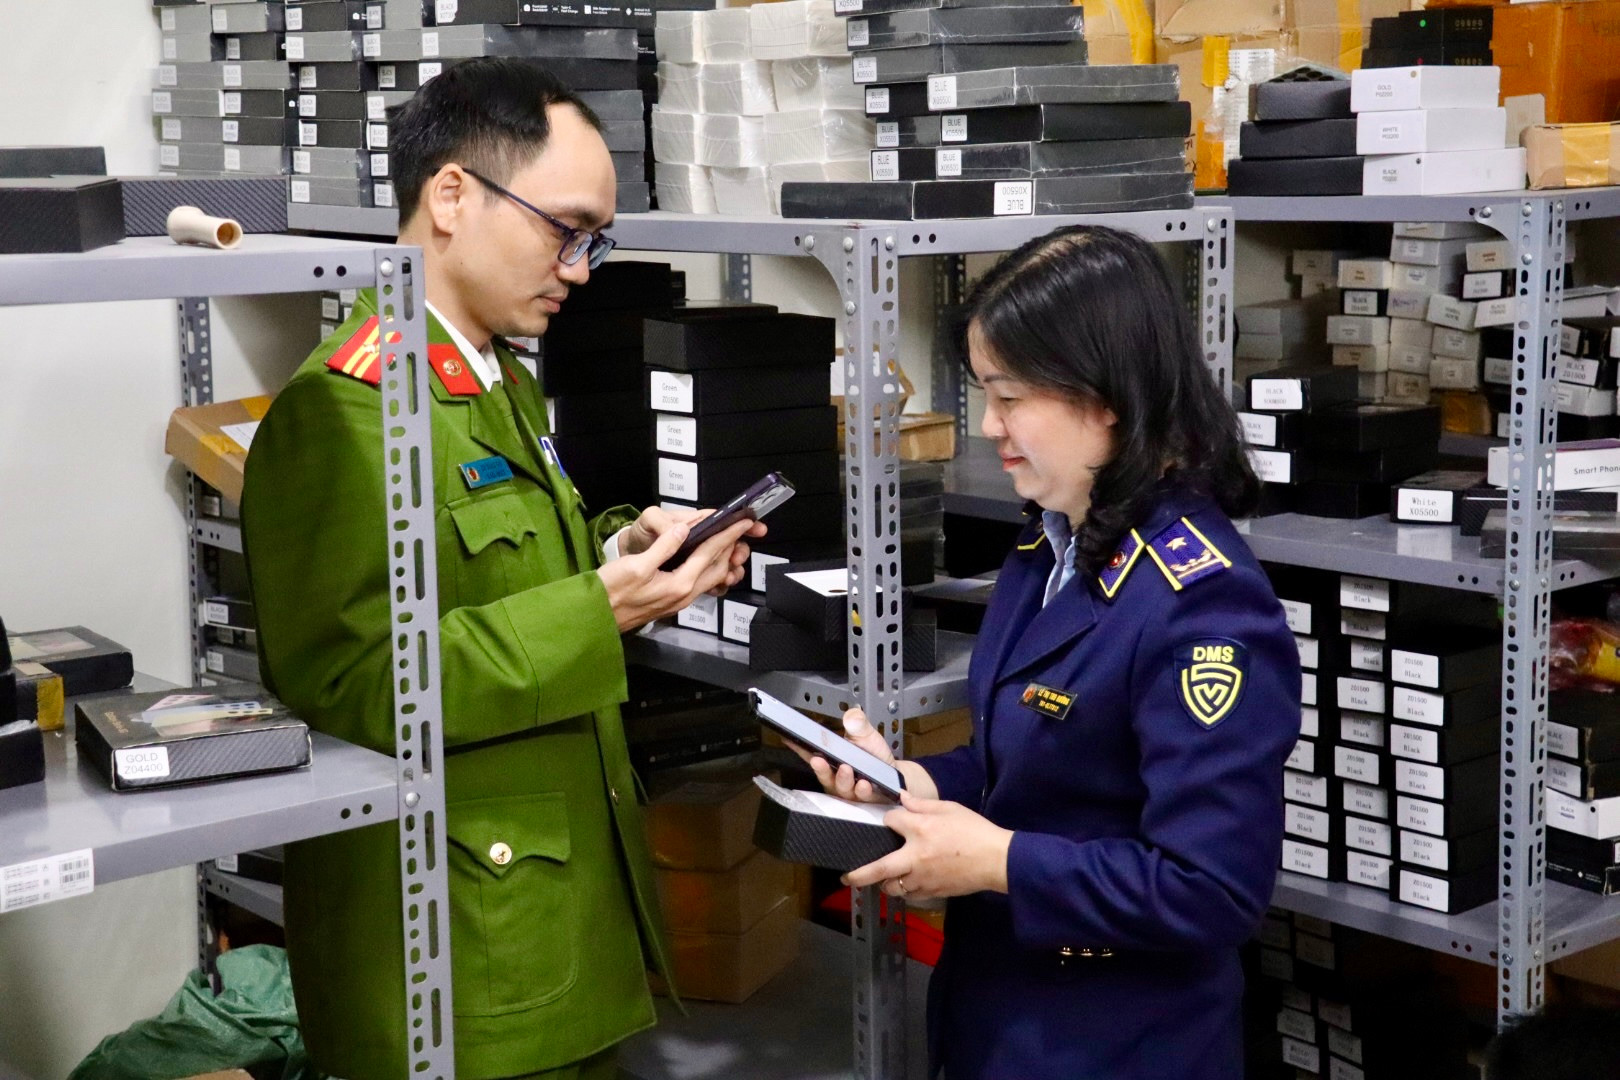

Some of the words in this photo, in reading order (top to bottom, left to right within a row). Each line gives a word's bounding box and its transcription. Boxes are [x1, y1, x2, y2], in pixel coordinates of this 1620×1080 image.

[856, 70, 874, 78] X05500
[934, 80, 948, 92] BLUE
[869, 102, 887, 110] X05500
[948, 118, 961, 126] BLUE
[882, 125, 894, 133] BLUE
[945, 128, 964, 137] X05500
[878, 154, 890, 164] BLUE
[942, 154, 956, 162] BLUE
[876, 168, 894, 176] X05500
[940, 163, 958, 172] X05500
[1002, 186, 1028, 196] X05500
[1007, 200, 1024, 210] BLUE
[1566, 362, 1586, 370] BLACK
[662, 382, 678, 392] Green
[667, 425, 682, 435] Green
[668, 470, 684, 480] Green
[1574, 466, 1597, 475] Smart
[1411, 497, 1437, 506] White
[1409, 508, 1439, 517] X05500
[1354, 595, 1372, 604] Black
[1352, 624, 1370, 632] Black
[1192, 646, 1234, 662] DMS
[1362, 658, 1380, 666] Black
[1404, 670, 1422, 680] Black
[1350, 697, 1368, 706] Black
[1407, 708, 1425, 717] Black
[1353, 729, 1370, 738] Black
[1403, 744, 1420, 754] Black
[126, 752, 158, 763] GOLD
[124, 764, 163, 774] Z04400
[1346, 766, 1363, 776] Black
[1408, 780, 1426, 790] Black
[1296, 788, 1312, 798] Black
[1355, 800, 1372, 810] Black
[1560, 806, 1575, 814] BLACK
[1410, 816, 1427, 826] Black
[1296, 824, 1313, 834] Black
[1358, 836, 1375, 846] Black
[1413, 851, 1430, 861] Black
[1294, 860, 1312, 870] Black
[1360, 872, 1377, 882] Black
[1412, 892, 1430, 902] Black
